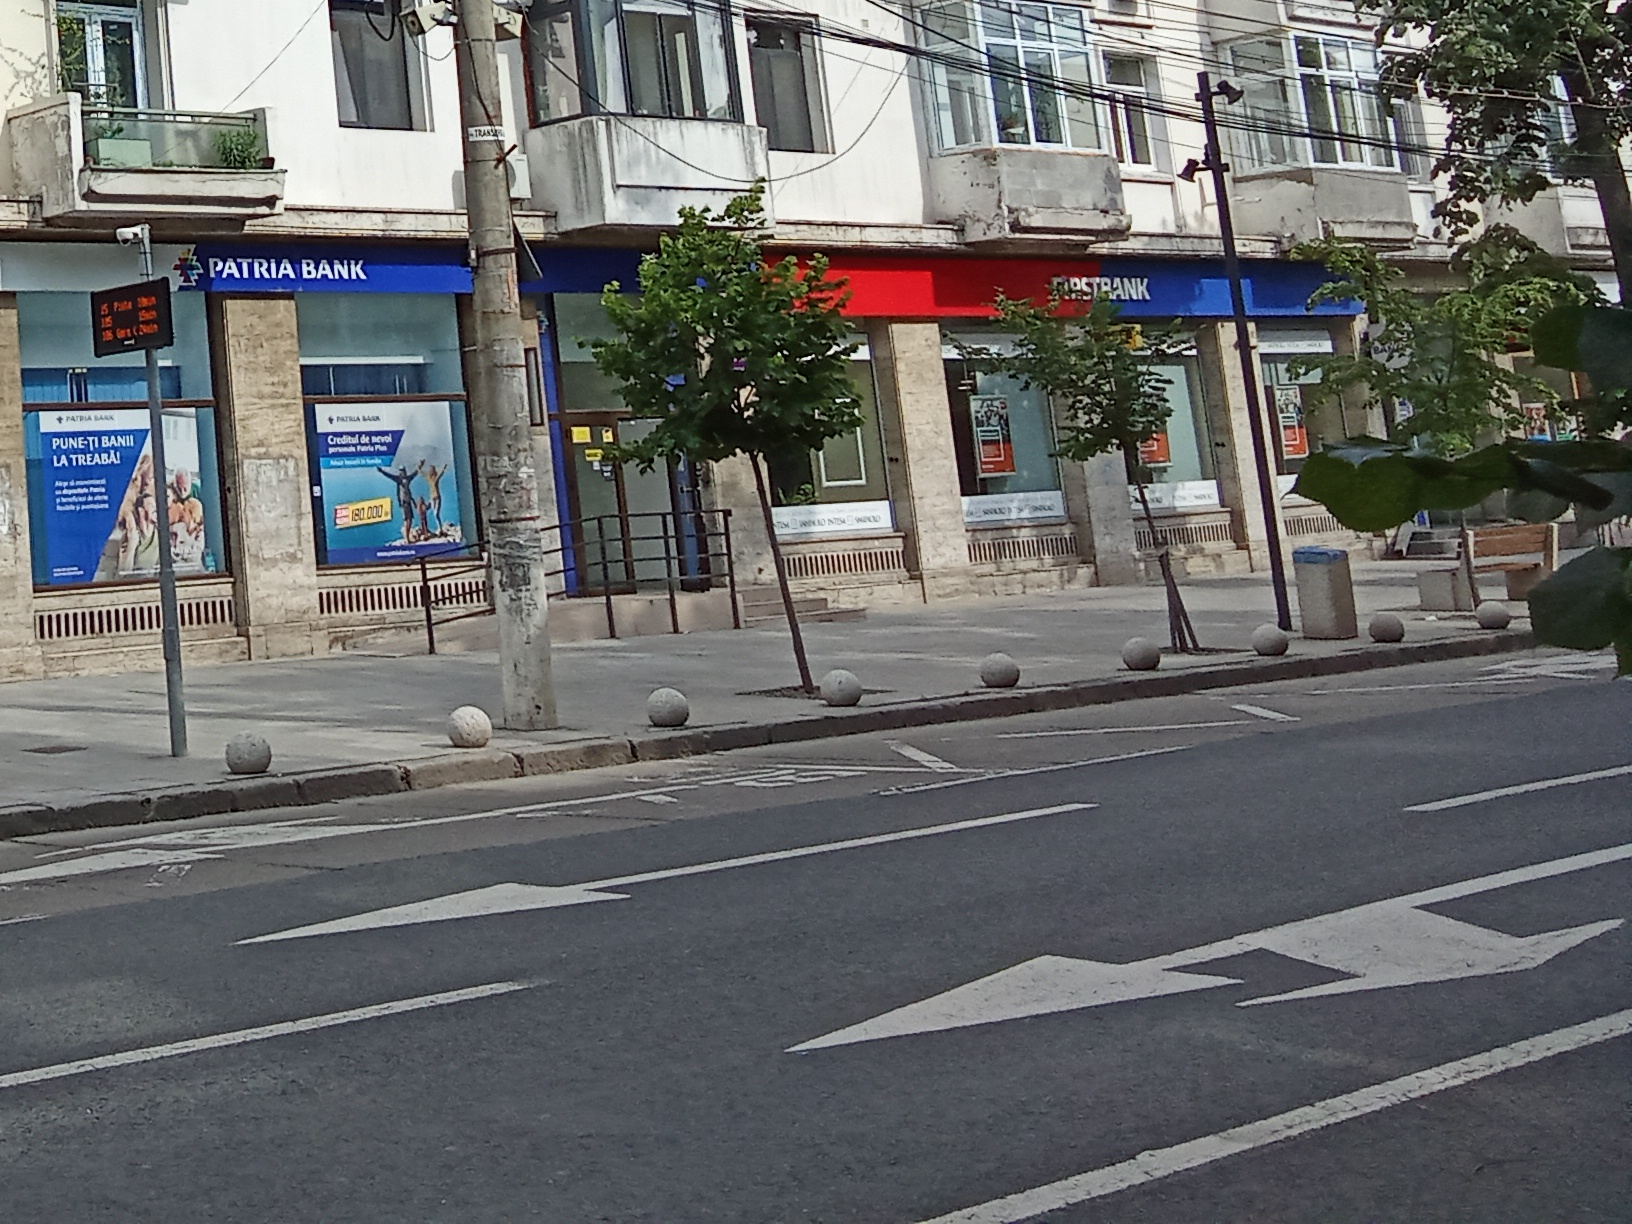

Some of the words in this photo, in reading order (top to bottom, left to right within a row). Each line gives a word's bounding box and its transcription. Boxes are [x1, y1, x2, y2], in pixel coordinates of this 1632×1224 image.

[209, 257, 296, 279] PATRIA
[301, 259, 367, 280] BANK
[336, 415, 360, 423] PATRIA
[101, 435, 134, 447] BANII
[328, 434, 359, 445] Creditul
[360, 434, 370, 444] de
[371, 433, 392, 444] nevoi
[375, 444, 387, 452] Plus
[53, 455, 68, 467] LA
[69, 450, 121, 466] TREABĂ!
[351, 504, 383, 522] 180.000
